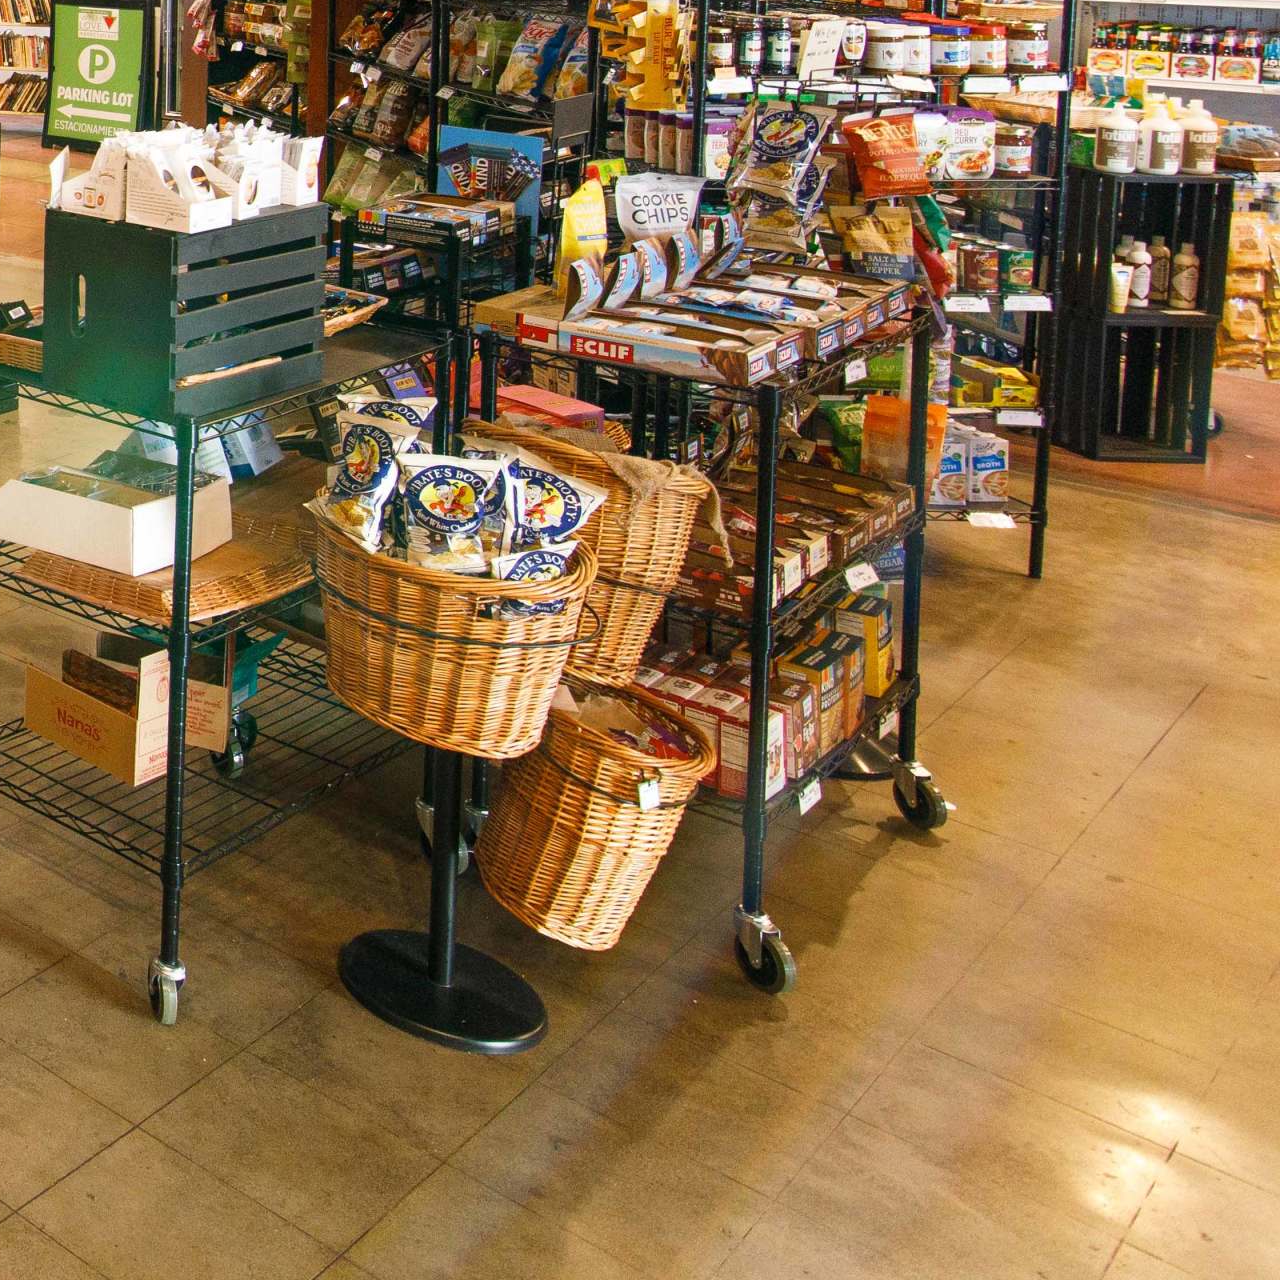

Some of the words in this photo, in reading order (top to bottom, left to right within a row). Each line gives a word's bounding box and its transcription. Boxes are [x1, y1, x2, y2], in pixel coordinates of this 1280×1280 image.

[88, 48, 110, 80] P
[57, 86, 111, 105] PARKING
[112, 92, 134, 108] LOT
[954, 128, 969, 136] RED
[954, 136, 977, 145] CURRY
[451, 163, 472, 195] KIND
[475, 158, 489, 190] KIND
[631, 193, 687, 207] COOKIE
[631, 207, 689, 224] CHIPS
[867, 255, 889, 263] SALT
[865, 267, 902, 276] PEPPER
[583, 341, 631, 360] CLIF
[976, 461, 1001, 470] BROTH
[410, 467, 452, 495] PIRATE'S
[520, 469, 553, 483] ATE'S
[56, 707, 101, 742] Nana's
